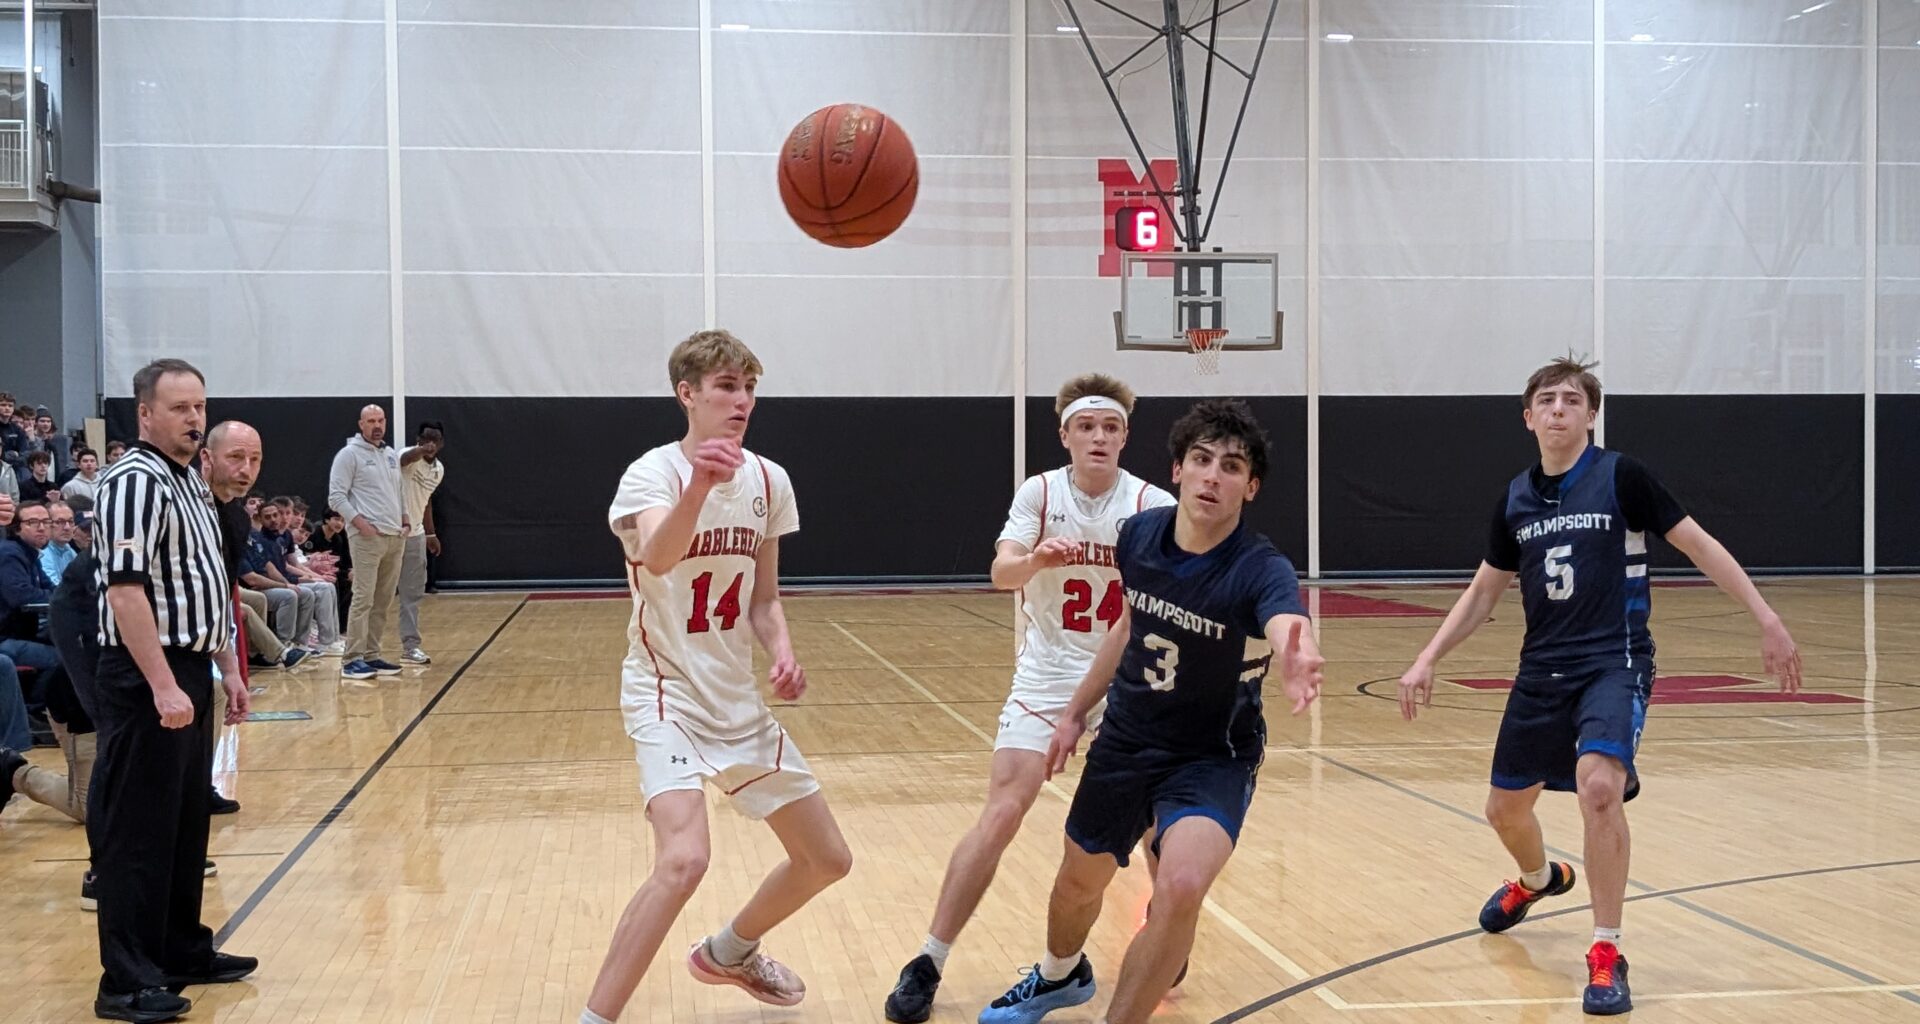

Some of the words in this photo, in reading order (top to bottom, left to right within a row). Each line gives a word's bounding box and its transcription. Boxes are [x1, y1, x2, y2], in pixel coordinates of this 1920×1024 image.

[1136, 210, 1158, 248] 6
[1544, 544, 1575, 600] 5
[687, 571, 745, 634] 14
[1062, 578, 1124, 633] 24
[1143, 632, 1180, 692] 3
